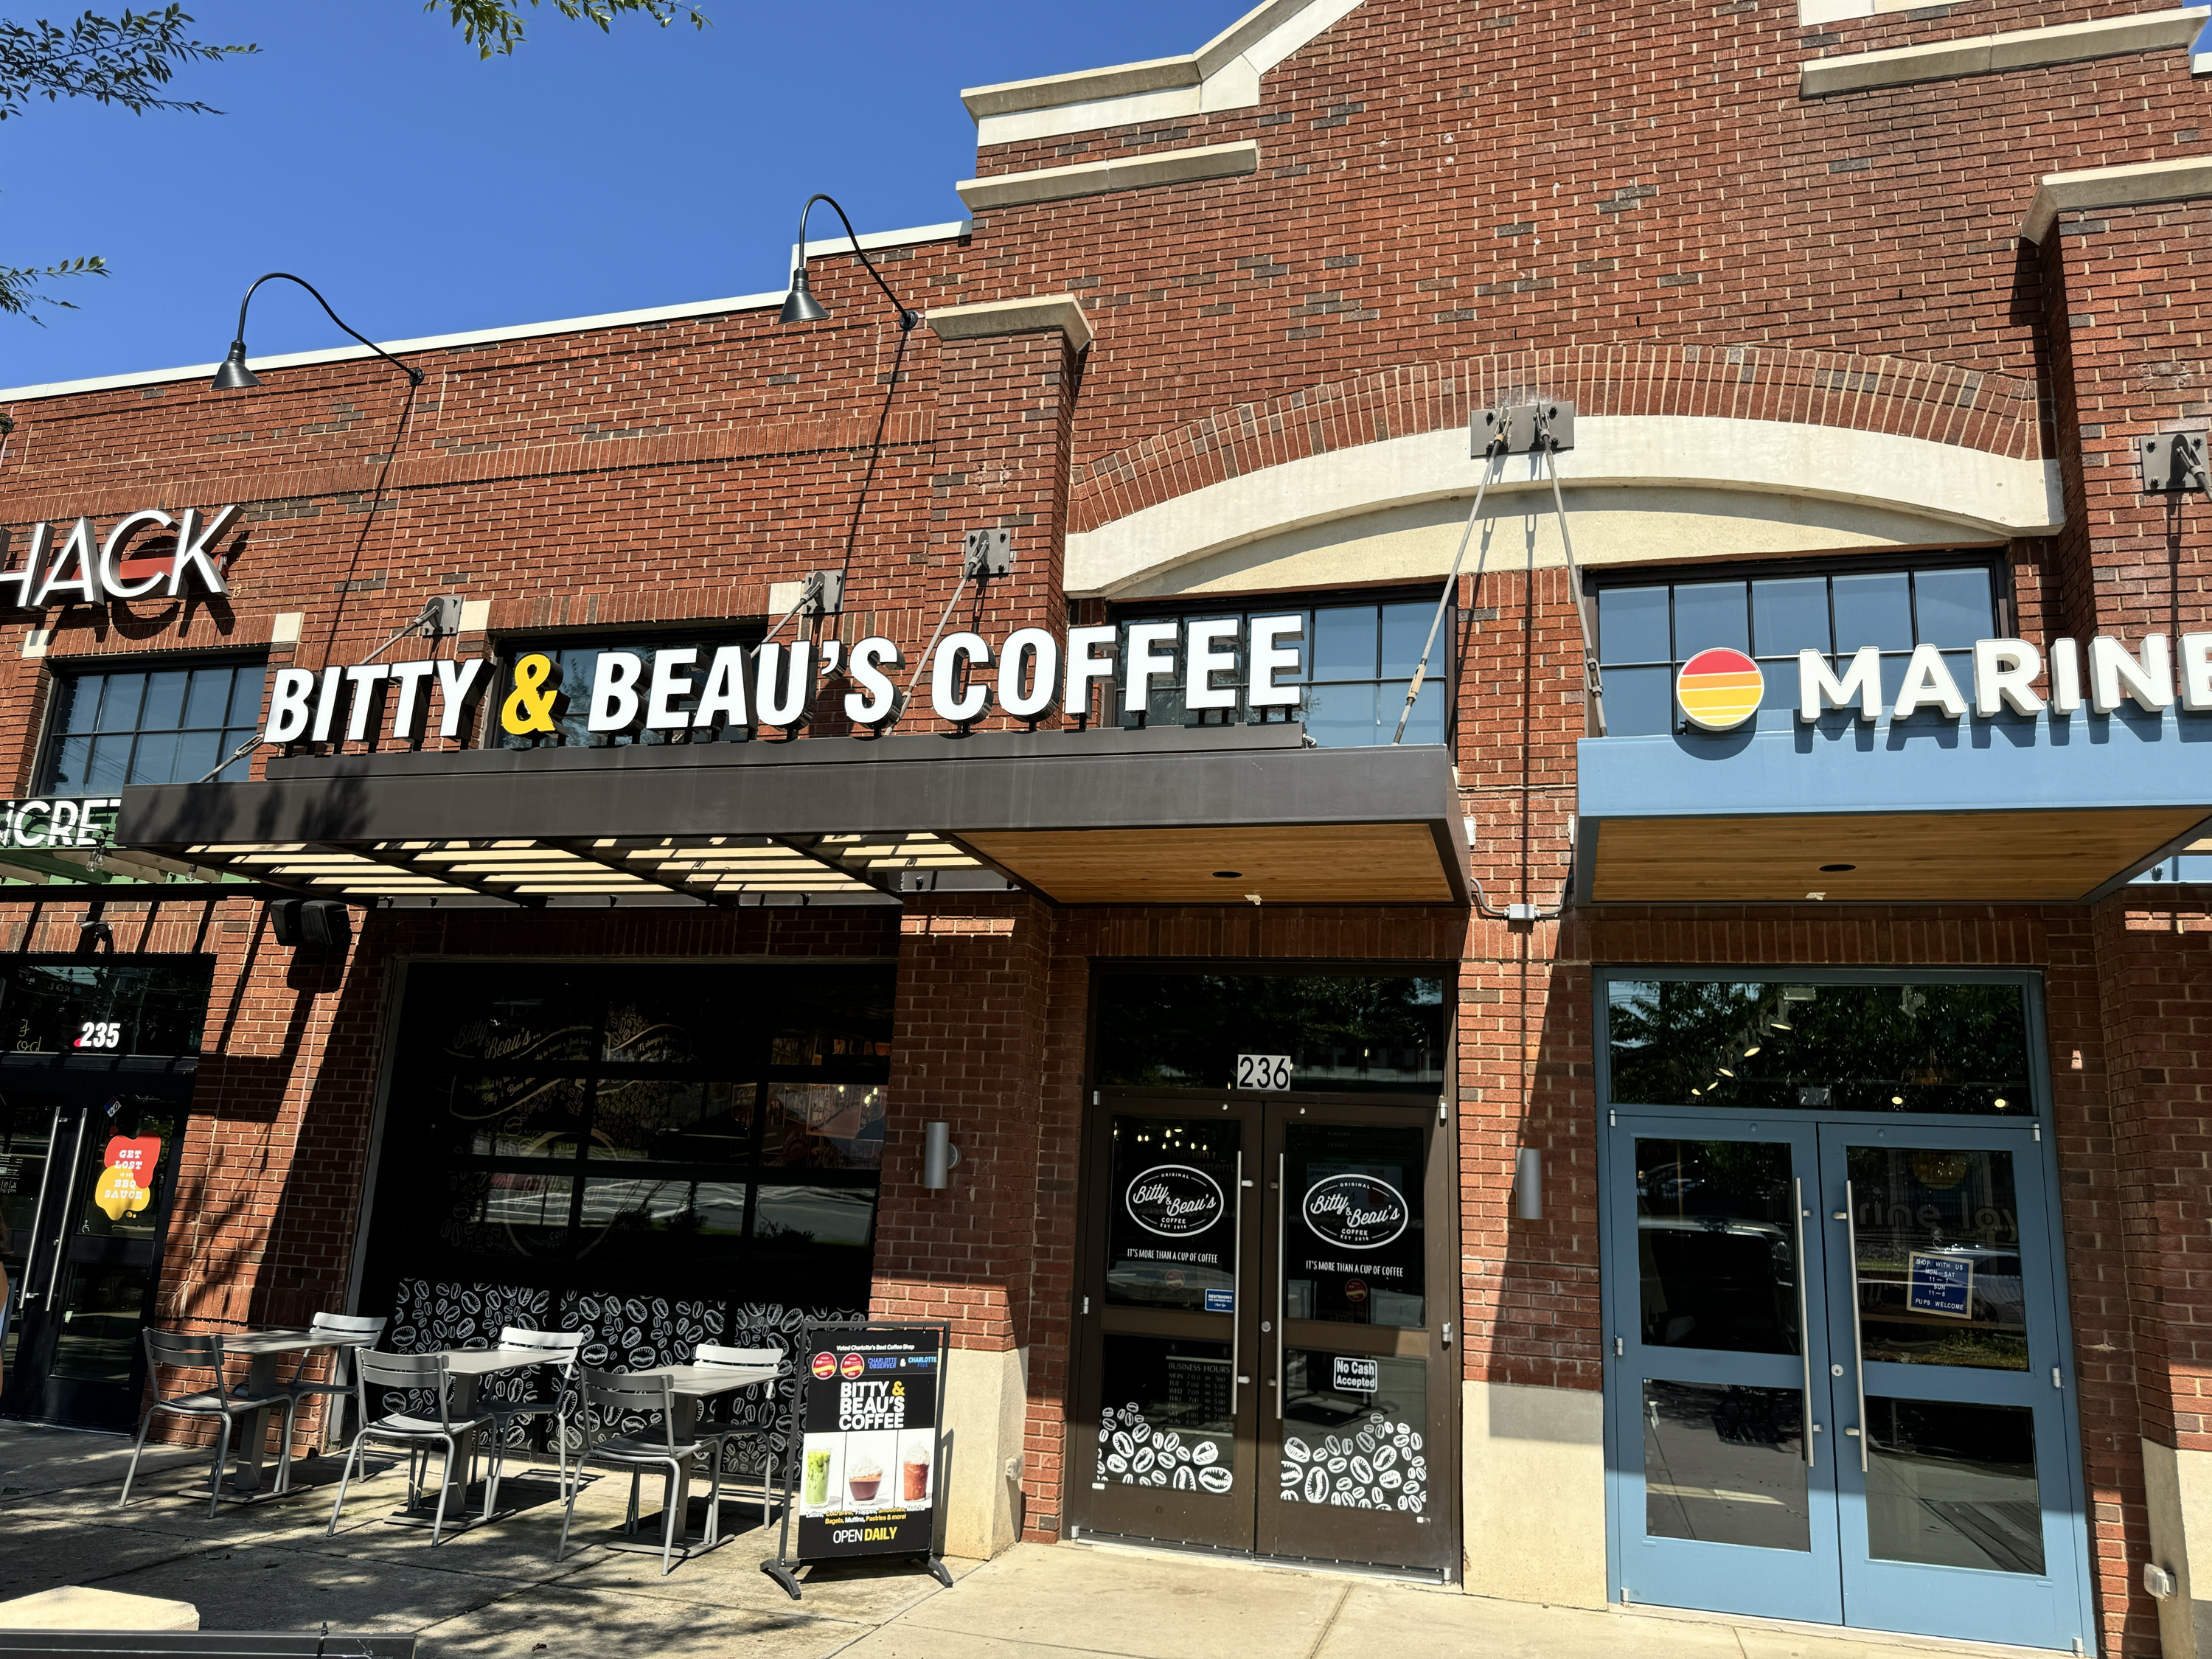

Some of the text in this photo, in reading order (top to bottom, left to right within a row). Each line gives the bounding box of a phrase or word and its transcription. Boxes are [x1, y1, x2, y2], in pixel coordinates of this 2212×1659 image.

[0, 504, 240, 608] HACK
[264, 613, 1305, 744] BITTY & BEAU'S COFFEE
[80, 1022, 121, 1048] 235
[1239, 1056, 1289, 1090] 236
[119, 1150, 142, 1159] GET
[114, 1161, 143, 1170] LOST
[114, 1179, 136, 1189] BBQ
[104, 1189, 142, 1200] SAUCE
[1133, 1183, 1217, 1217] Bitty & Beau's
[1310, 1193, 1400, 1228] Bitty & Beau's
[1341, 1228, 1368, 1237] COFFEE
[1127, 1248, 1218, 1264] IT'S MORE THAN A CUP OF COFFEE
[1306, 1260, 1403, 1277] IT'S MORE THAN A CUP OF COFFEE
[1935, 1301, 1964, 1310] WELCOME
[900, 1358, 906, 1367] &
[1168, 1362, 1231, 1374] BUSINESS HOURS
[1336, 1360, 1375, 1376] No Cash
[840, 1380, 905, 1398] BITTY &
[1336, 1374, 1375, 1388] Accepted
[839, 1396, 905, 1415] BEAU'S
[839, 1412, 905, 1430] COFFEE
[833, 1526, 897, 1543] OPEN DAILY
